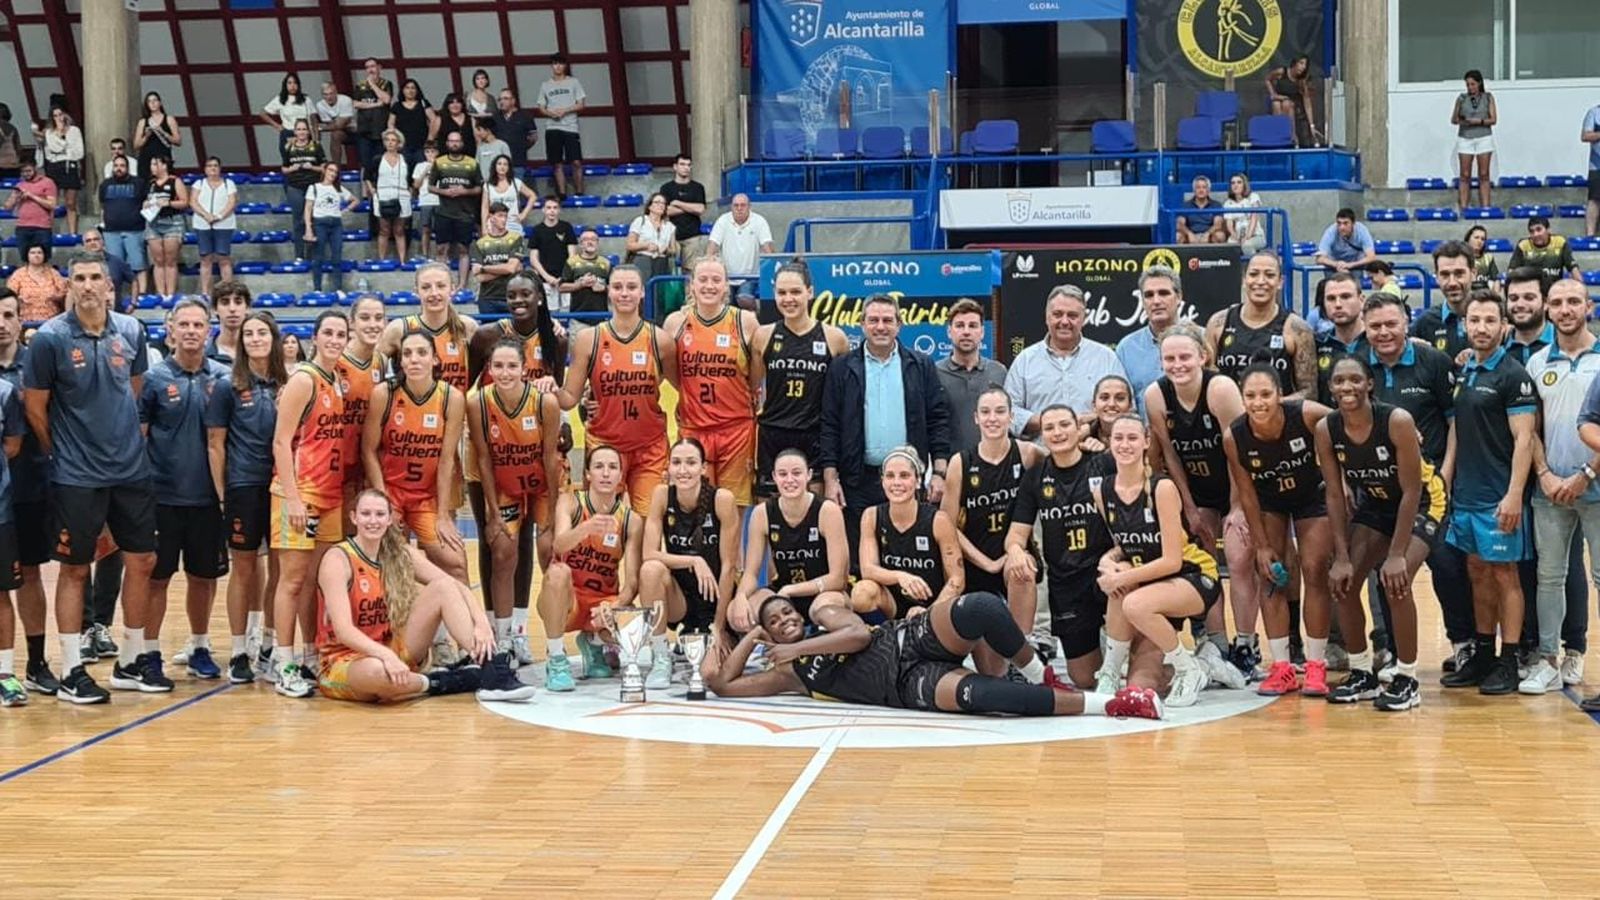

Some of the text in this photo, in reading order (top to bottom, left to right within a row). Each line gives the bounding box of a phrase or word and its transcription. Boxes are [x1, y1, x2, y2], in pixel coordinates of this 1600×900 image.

[845, 10, 923, 24] Ayuntamiento de
[823, 23, 924, 39] Alcantarilla
[1033, 208, 1091, 221] Alcantarilla
[832, 260, 920, 277] HOZONO
[1056, 259, 1137, 275] HOZONO
[682, 351, 726, 365] Cultura
[600, 369, 647, 383] Cultura
[682, 365, 736, 378] Esfuerzo
[600, 384, 656, 397] Esfuerzo
[701, 383, 715, 404] 21
[786, 379, 804, 398] 13
[623, 400, 639, 420] 14
[389, 429, 433, 445] Cultura
[491, 442, 532, 456] Cultura
[329, 449, 340, 472] 2
[404, 462, 423, 482] 5
[1186, 461, 1210, 477] 20
[517, 473, 541, 489] 16
[1276, 476, 1296, 492] 10
[1368, 486, 1389, 499] 15
[1066, 528, 1087, 551] 19
